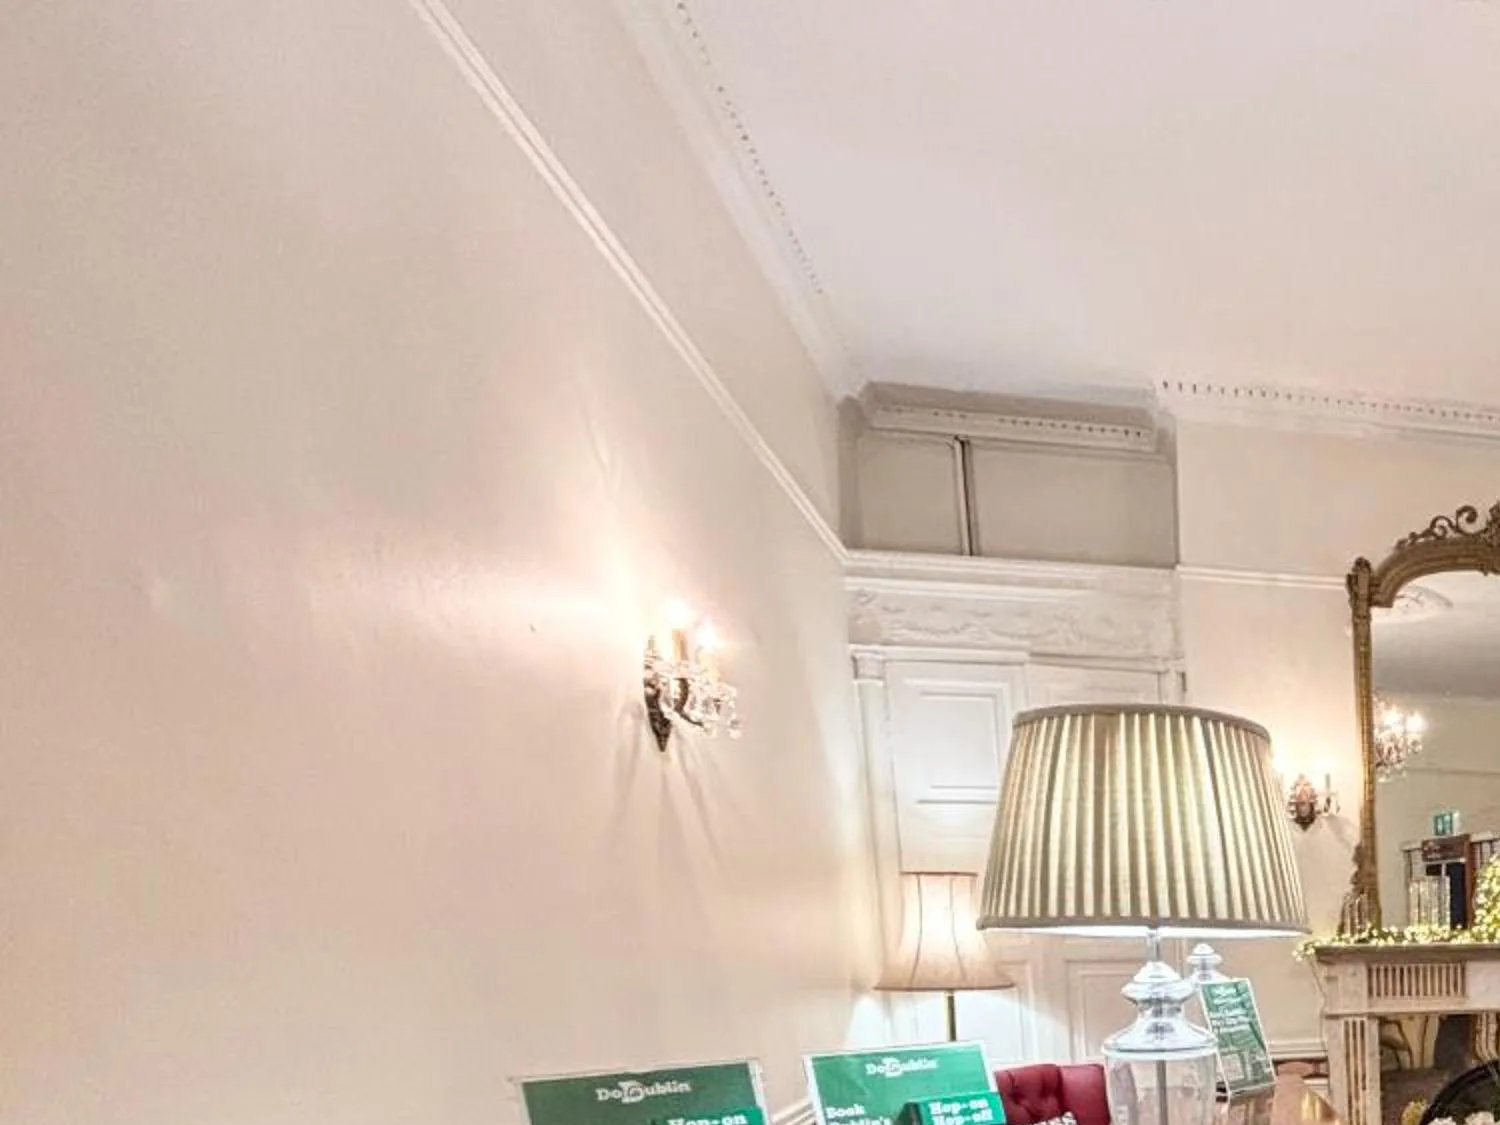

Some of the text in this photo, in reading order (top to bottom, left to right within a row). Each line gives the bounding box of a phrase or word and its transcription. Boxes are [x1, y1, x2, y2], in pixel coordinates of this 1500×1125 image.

[595, 1080, 691, 1104] DoDublin
[825, 1103, 865, 1119] Book
[928, 1098, 989, 1115] Hop-on
